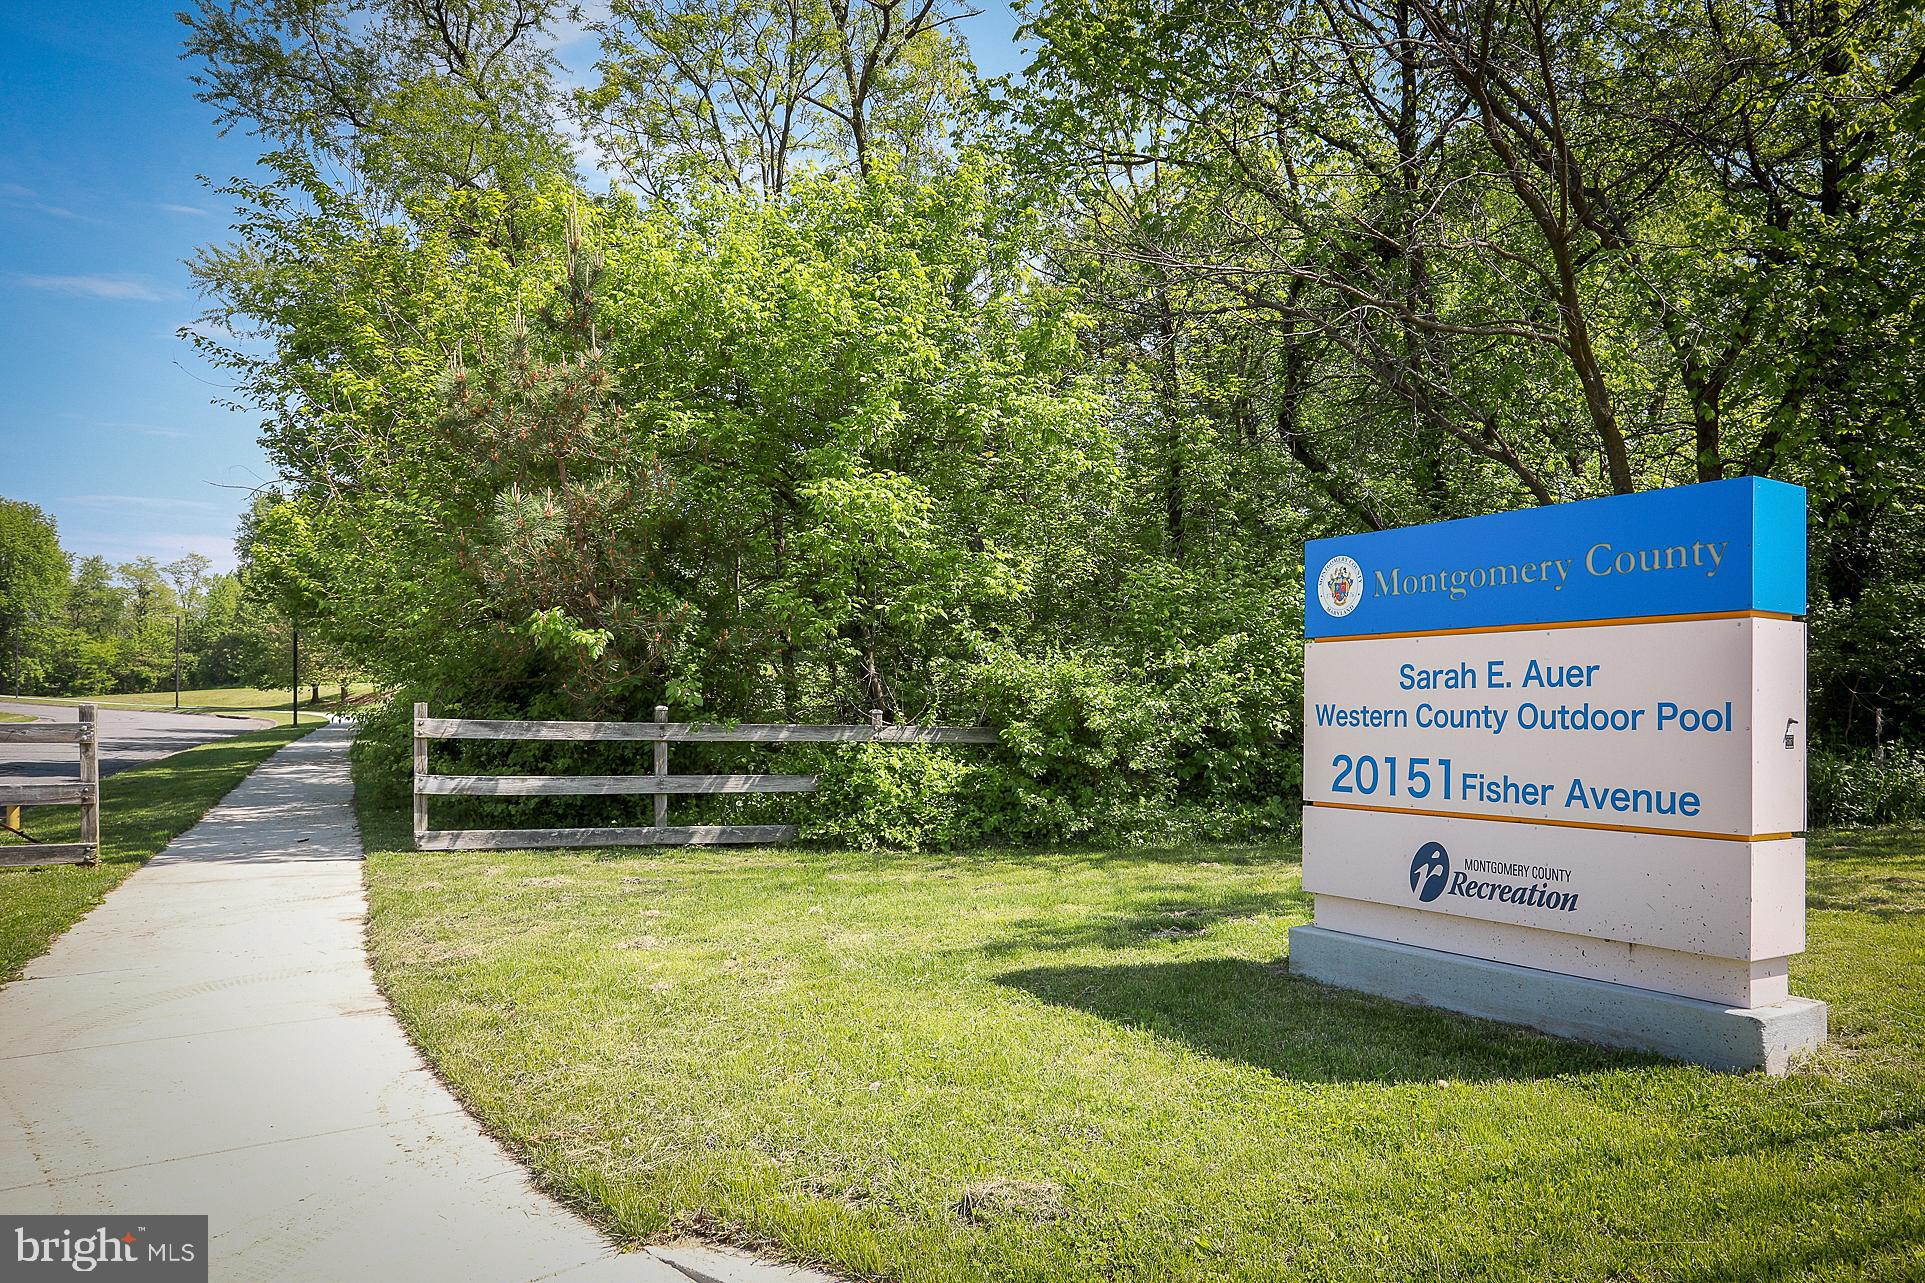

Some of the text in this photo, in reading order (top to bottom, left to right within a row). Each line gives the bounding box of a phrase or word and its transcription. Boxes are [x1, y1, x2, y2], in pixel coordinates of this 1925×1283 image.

[1373, 540, 1729, 600] Montgomery County
[1399, 659, 1600, 690] Sarah E. Auer
[1315, 701, 1733, 735] Western County Outdoor Pool
[1331, 754, 1701, 818] 20151 Fisher Avenue
[1464, 858, 1572, 883] MONTGOMERY COUNTY
[1448, 870, 1579, 912] Recreation
